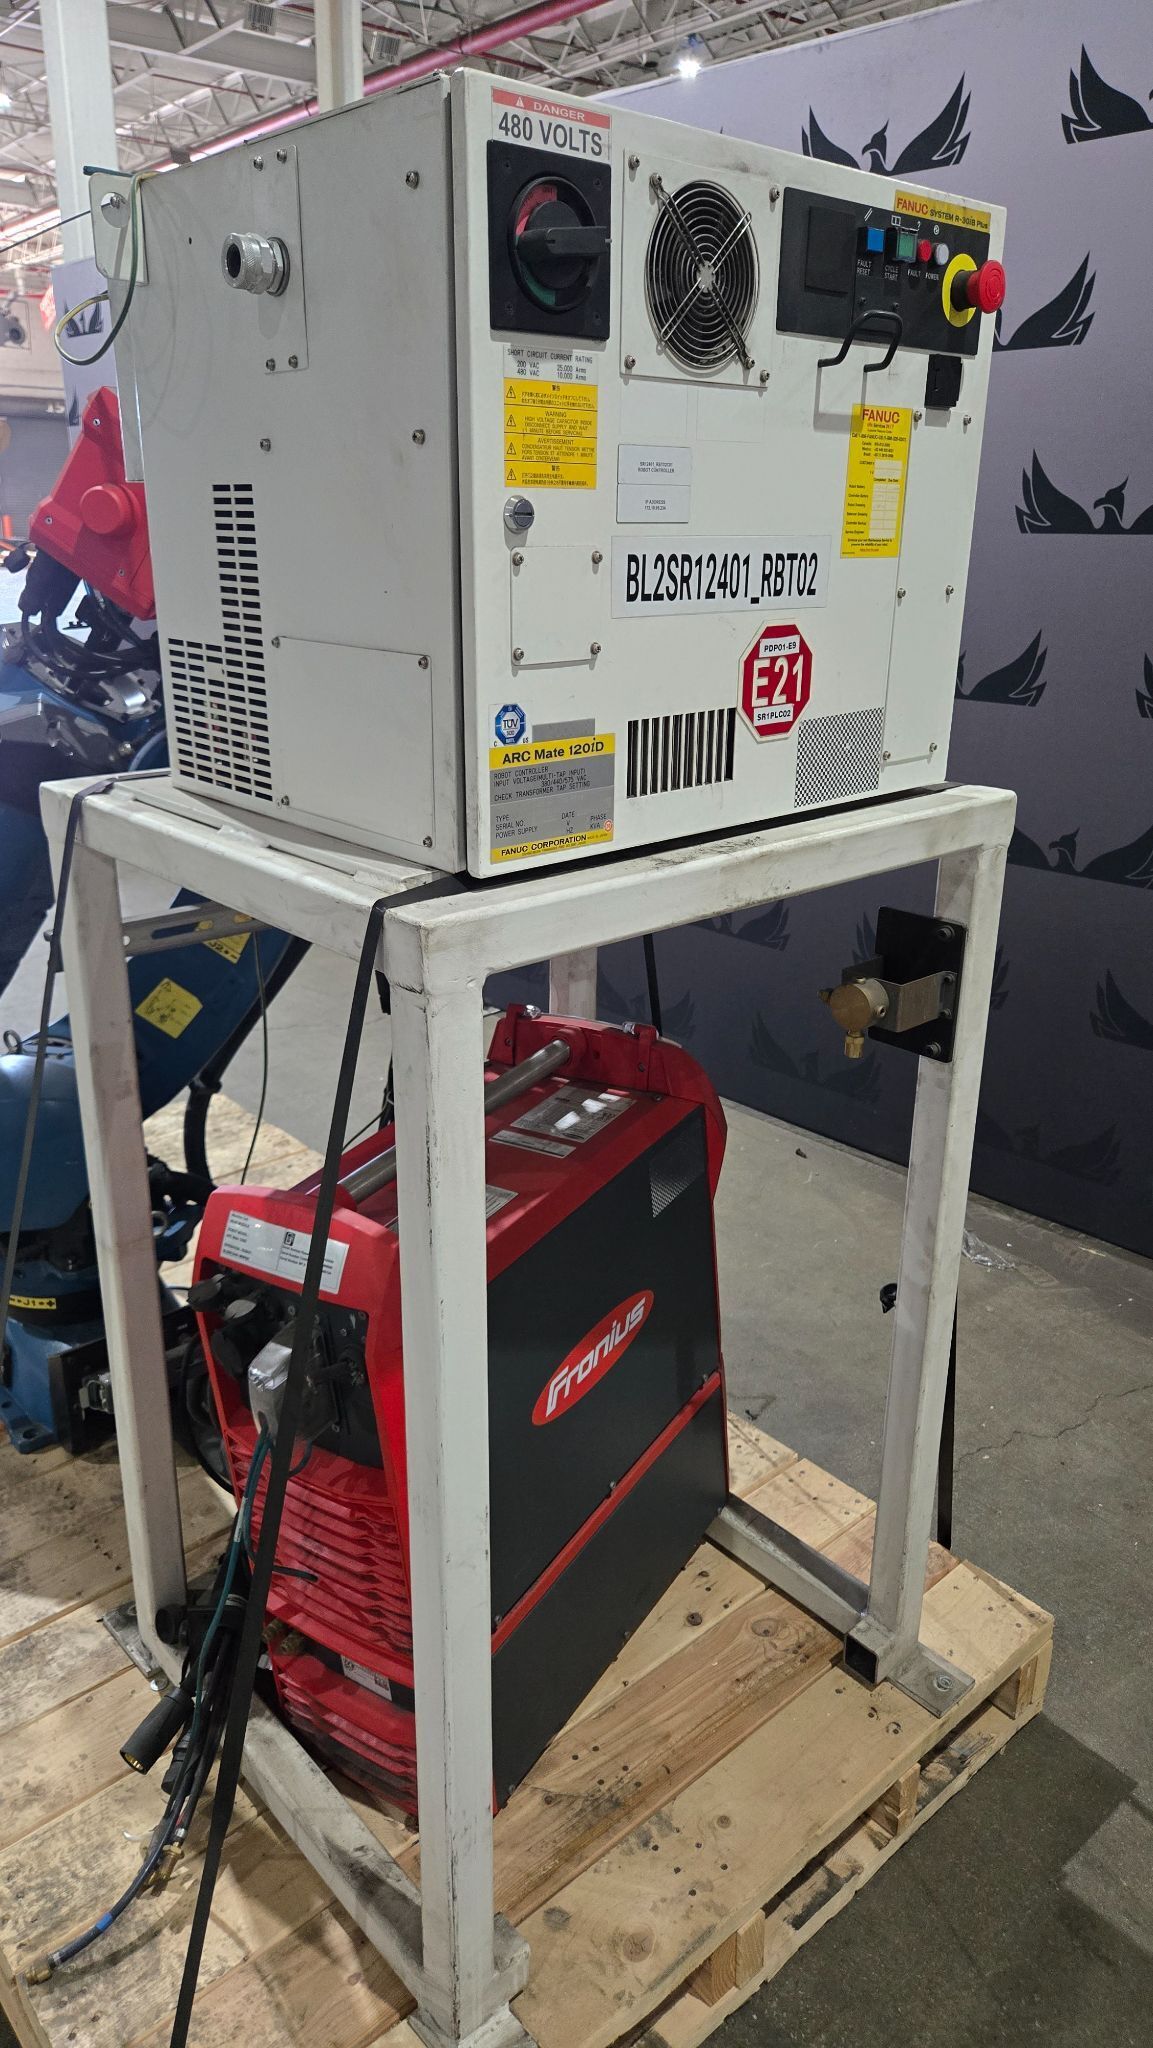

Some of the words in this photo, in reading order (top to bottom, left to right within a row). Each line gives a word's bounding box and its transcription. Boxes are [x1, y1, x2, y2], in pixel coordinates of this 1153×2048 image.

[534, 102, 585, 122] DANGER
[499, 112, 533, 140] 480
[539, 119, 602, 156] VOLTS
[897, 198, 928, 215] FANUC
[930, 209, 953, 222] SYSTEM
[857, 259, 872, 268] FAULT
[908, 269, 921, 277] FAULT
[527, 351, 547, 359] CIRCUIT
[550, 352, 572, 361] CURRENT
[575, 356, 592, 364] RATING
[862, 409, 900, 423] FANUC
[626, 553, 818, 604] BL2SR12401_RBT02
[764, 642, 796, 652] PDP01-E9
[752, 654, 804, 708] E21
[757, 710, 791, 721] SR1PLC02
[502, 750, 530, 764] ARC
[535, 746, 564, 760] Mate
[569, 737, 604, 755] 120iD
[515, 766, 549, 777] CONTROLLER
[494, 779, 509, 788] INPUT
[494, 793, 512, 801] CHECK
[516, 787, 553, 798] TRANSFORMER
[569, 781, 590, 790] SETTING
[562, 811, 575, 819] DATE
[496, 822, 514, 831] SERIAL
[496, 830, 515, 839] POWER
[518, 826, 538, 836] SUPPLY
[501, 846, 528, 856] FANUC
[531, 834, 587, 851] CORPORATION
[546, 1297, 646, 1417] Fronius
